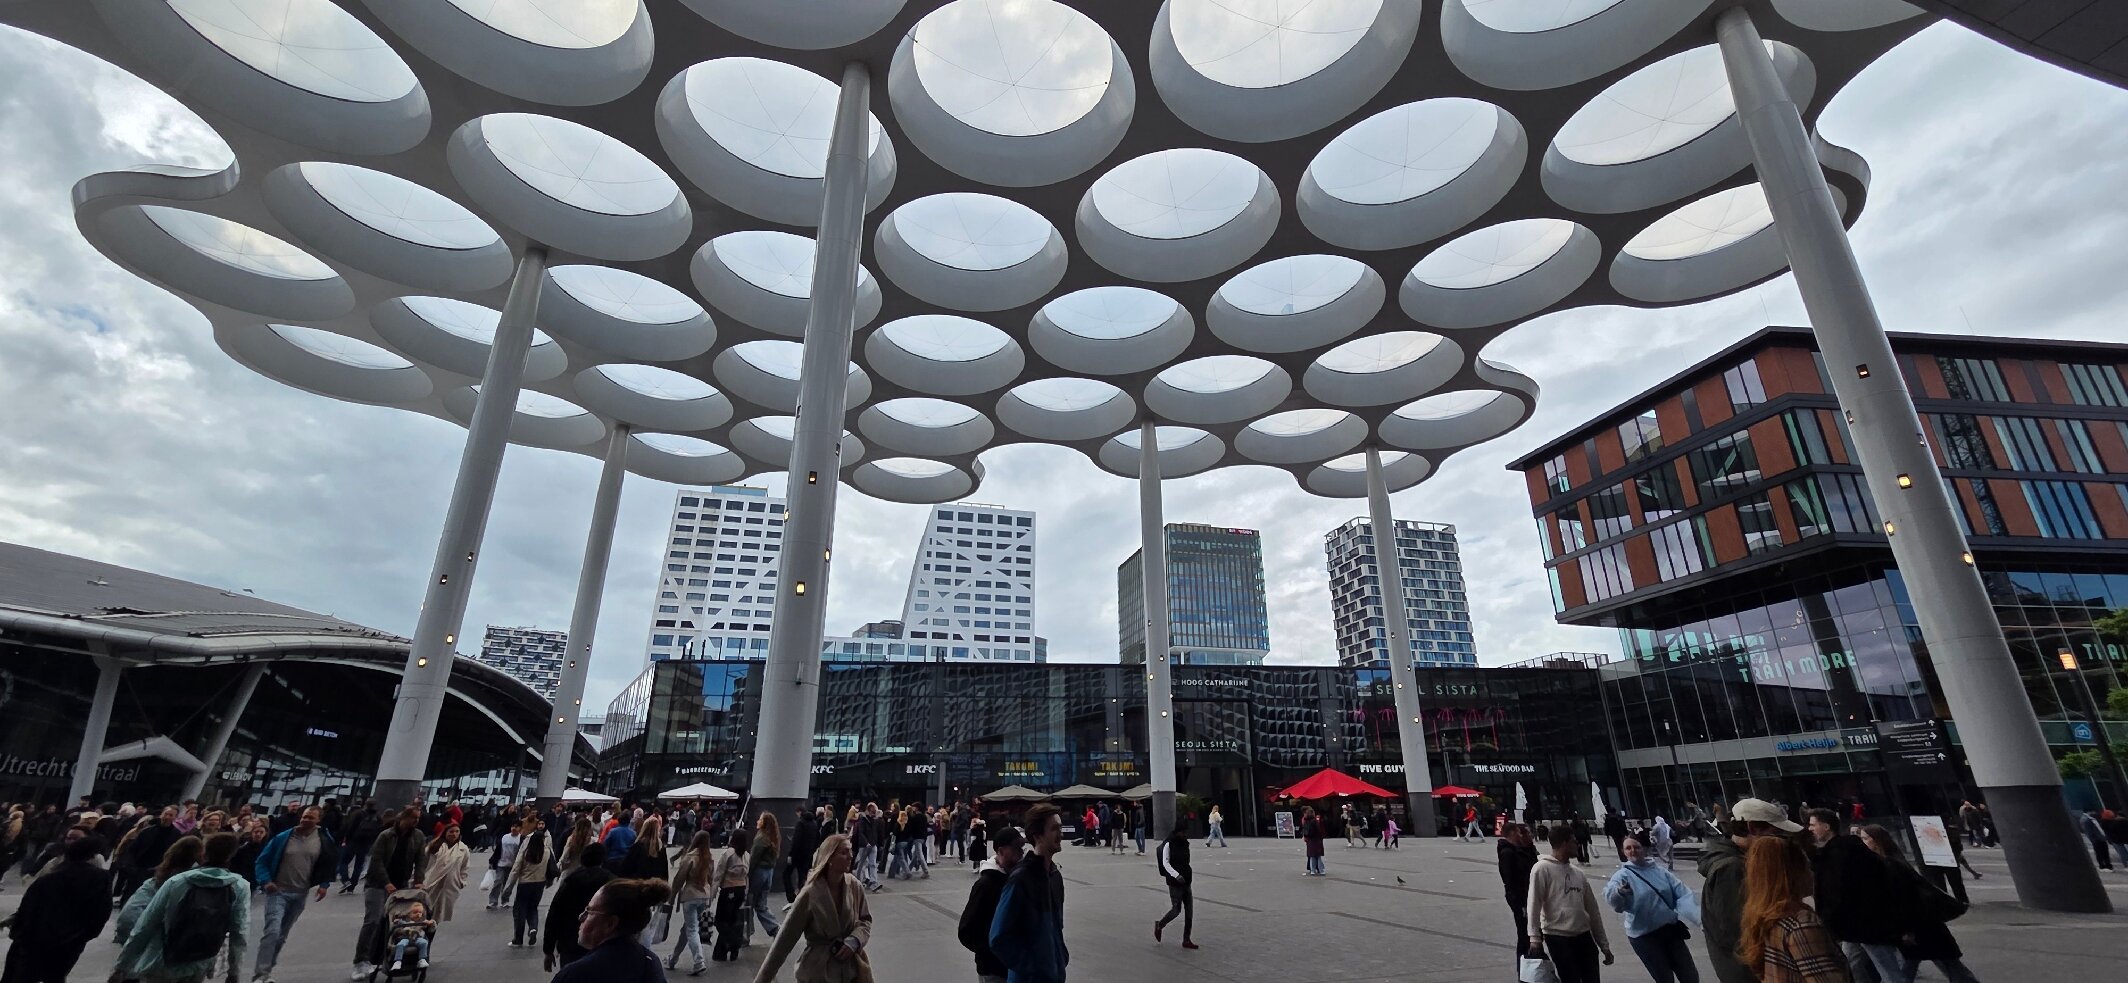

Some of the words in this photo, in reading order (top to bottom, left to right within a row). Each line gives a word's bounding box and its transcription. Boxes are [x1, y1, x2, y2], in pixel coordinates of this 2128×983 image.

[1739, 659, 1795, 683] TRAIN
[1800, 650, 1857, 673] MORE
[1204, 679, 1249, 687] CATHARIJNE
[1376, 684, 1426, 695] SEL
[1435, 684, 1478, 695] SISTA
[0, 753, 68, 777] Utrecht
[811, 765, 835, 774] KFC
[913, 765, 937, 774] KFC
[1005, 761, 1039, 771] TAKUMI
[1360, 764, 1383, 773] FIVE
[1384, 764, 1405, 773] GUY
[1474, 765, 1489, 773] THE
[1489, 764, 1520, 773] SEAFOOD
[1521, 765, 1535, 773] BAR
